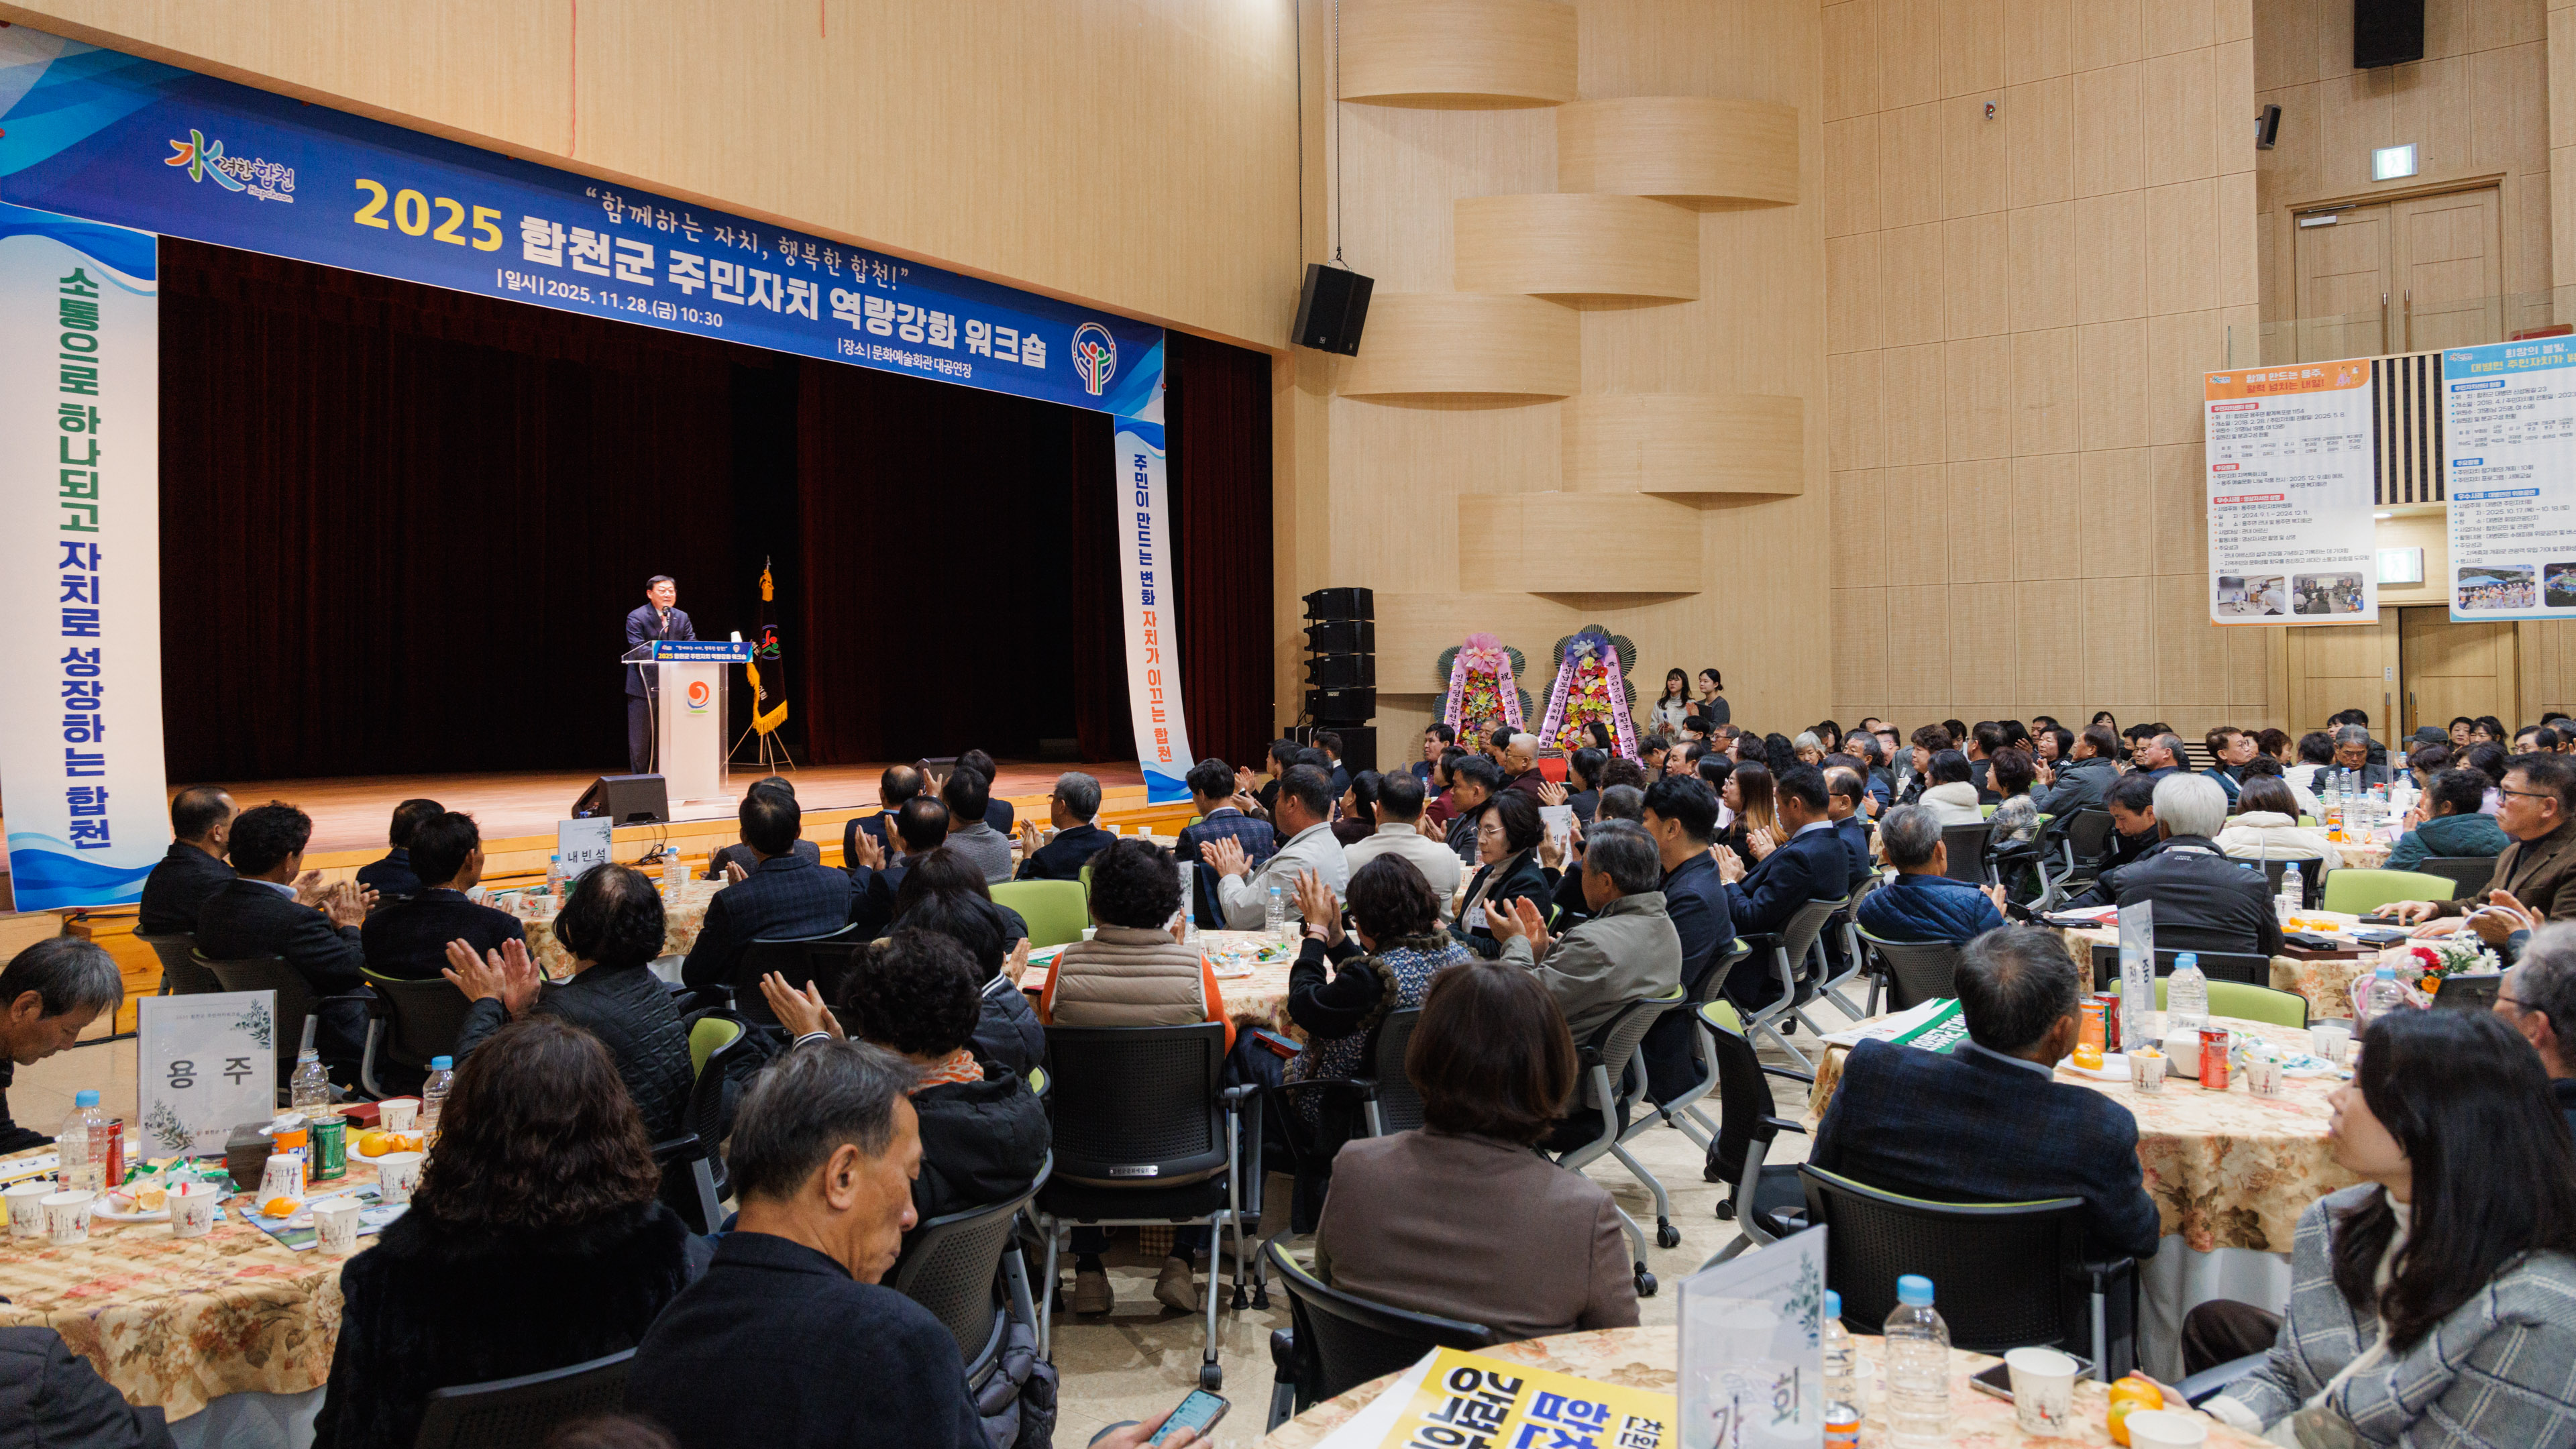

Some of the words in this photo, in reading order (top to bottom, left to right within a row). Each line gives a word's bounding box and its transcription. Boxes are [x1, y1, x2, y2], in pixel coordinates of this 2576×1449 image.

[247, 184, 293, 203] Hapcheon
[354, 178, 503, 252] 2025
[521, 215, 654, 286] 합천군
[668, 250, 818, 321] 주민자치
[829, 288, 957, 350] 역량강화
[965, 319, 1046, 369] 워크숍
[714, 225, 768, 260] 자치,
[779, 235, 842, 277] 행복한
[547, 280, 595, 305] 2025.
[599, 291, 624, 310] 11.
[627, 296, 678, 321] 28.(금)
[680, 307, 723, 327] 10:30
[59, 267, 99, 396] 소통으로
[2506, 346, 2538, 358] 희망의
[871, 345, 933, 372] 문화예술회관
[934, 358, 973, 378] 대공연장
[2247, 372, 2265, 383] 함께
[2269, 370, 2298, 380] 만드는
[2302, 368, 2324, 379] 용주,
[2247, 384, 2265, 394] 활력
[2269, 382, 2298, 392] 넘치는
[2302, 379, 2324, 389] 내일!
[2471, 361, 2504, 372] 대병면
[2508, 355, 2563, 369] 주민자치가
[58, 402, 101, 533] 하나되고
[1134, 453, 1149, 508] 주민이
[1136, 512, 1152, 566] 만드는
[59, 541, 102, 637] 자치로
[1140, 570, 1155, 605] 변화
[1142, 610, 1160, 664] 자치가
[60, 647, 105, 777] 성장하는
[1148, 669, 1165, 722] 이끄는
[1505, 690, 1519, 725] 주민자치
[1610, 675, 1624, 706] 2025년
[1618, 711, 1631, 731] 합천군
[1154, 727, 1173, 763] 합천
[65, 786, 112, 851] 합천
